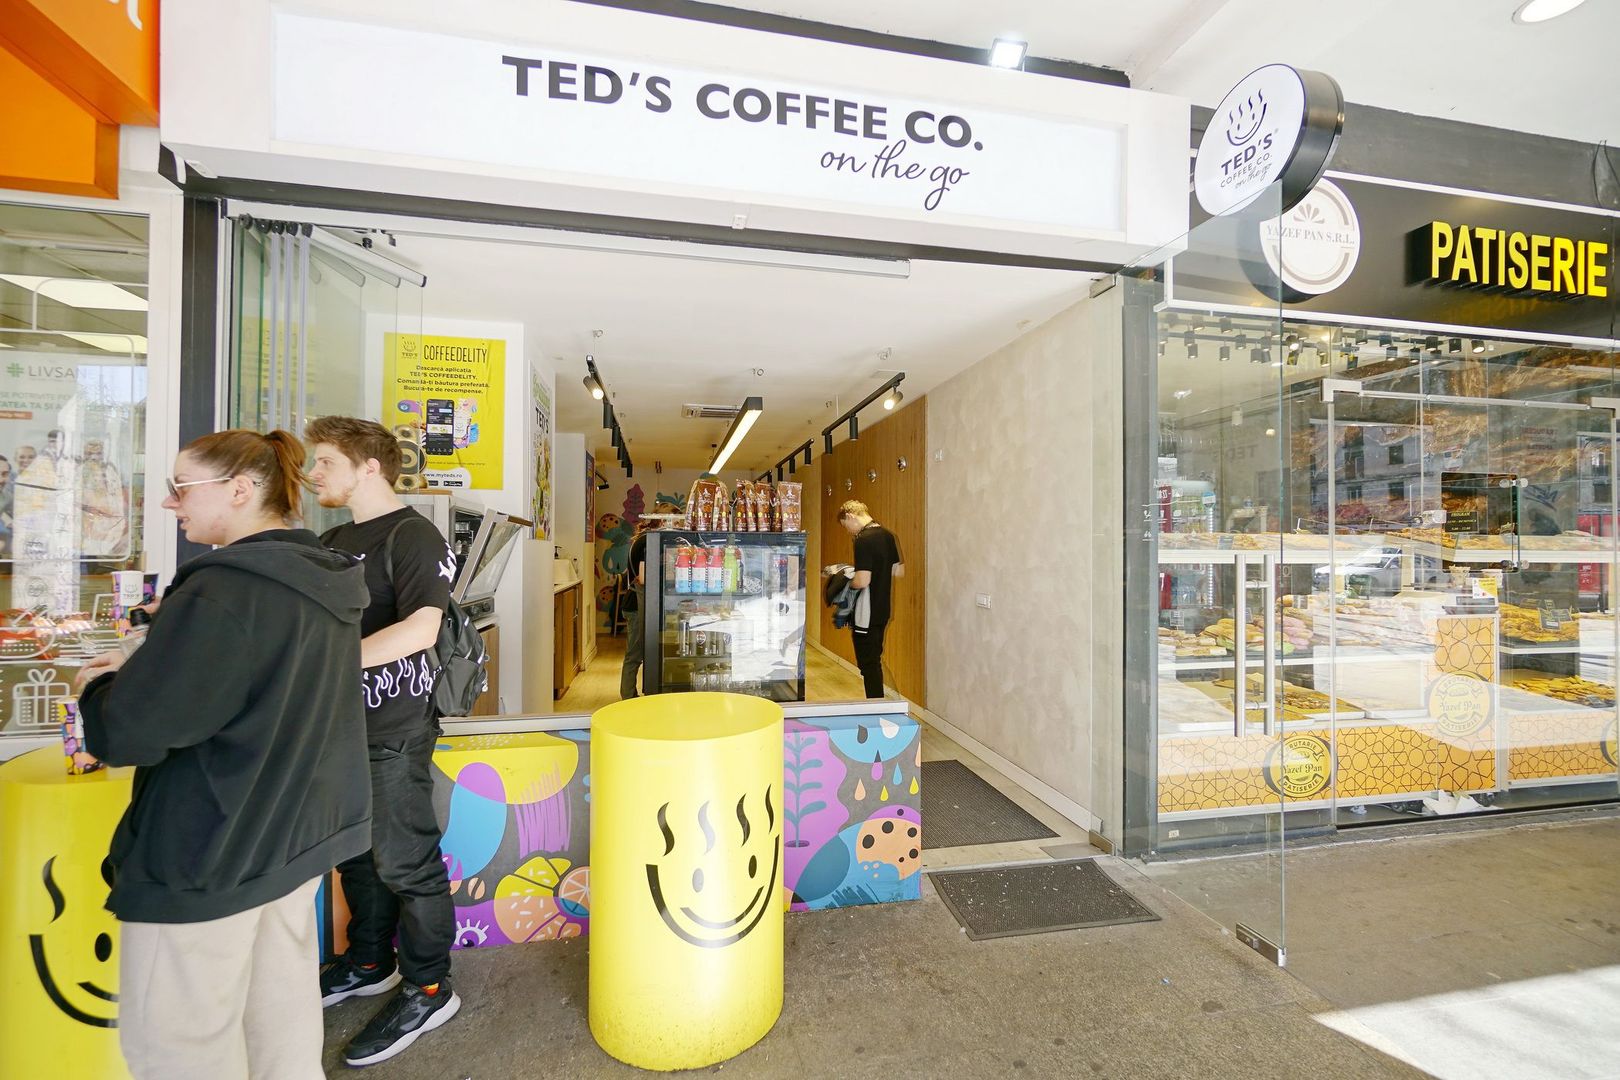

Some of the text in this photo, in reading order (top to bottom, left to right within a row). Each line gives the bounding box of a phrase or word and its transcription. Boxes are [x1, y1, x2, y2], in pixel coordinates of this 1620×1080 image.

[502, 55, 984, 151] TED'S COFFEE CO.
[820, 139, 970, 211] on the go
[1220, 152, 1273, 188] COFFEE CO.
[1221, 133, 1272, 176] TED'S
[1267, 225, 1355, 244] YAZEF PAN S.R.L.
[1432, 220, 1608, 298] PATISERIE
[423, 344, 487, 364] COFFEEDELITY
